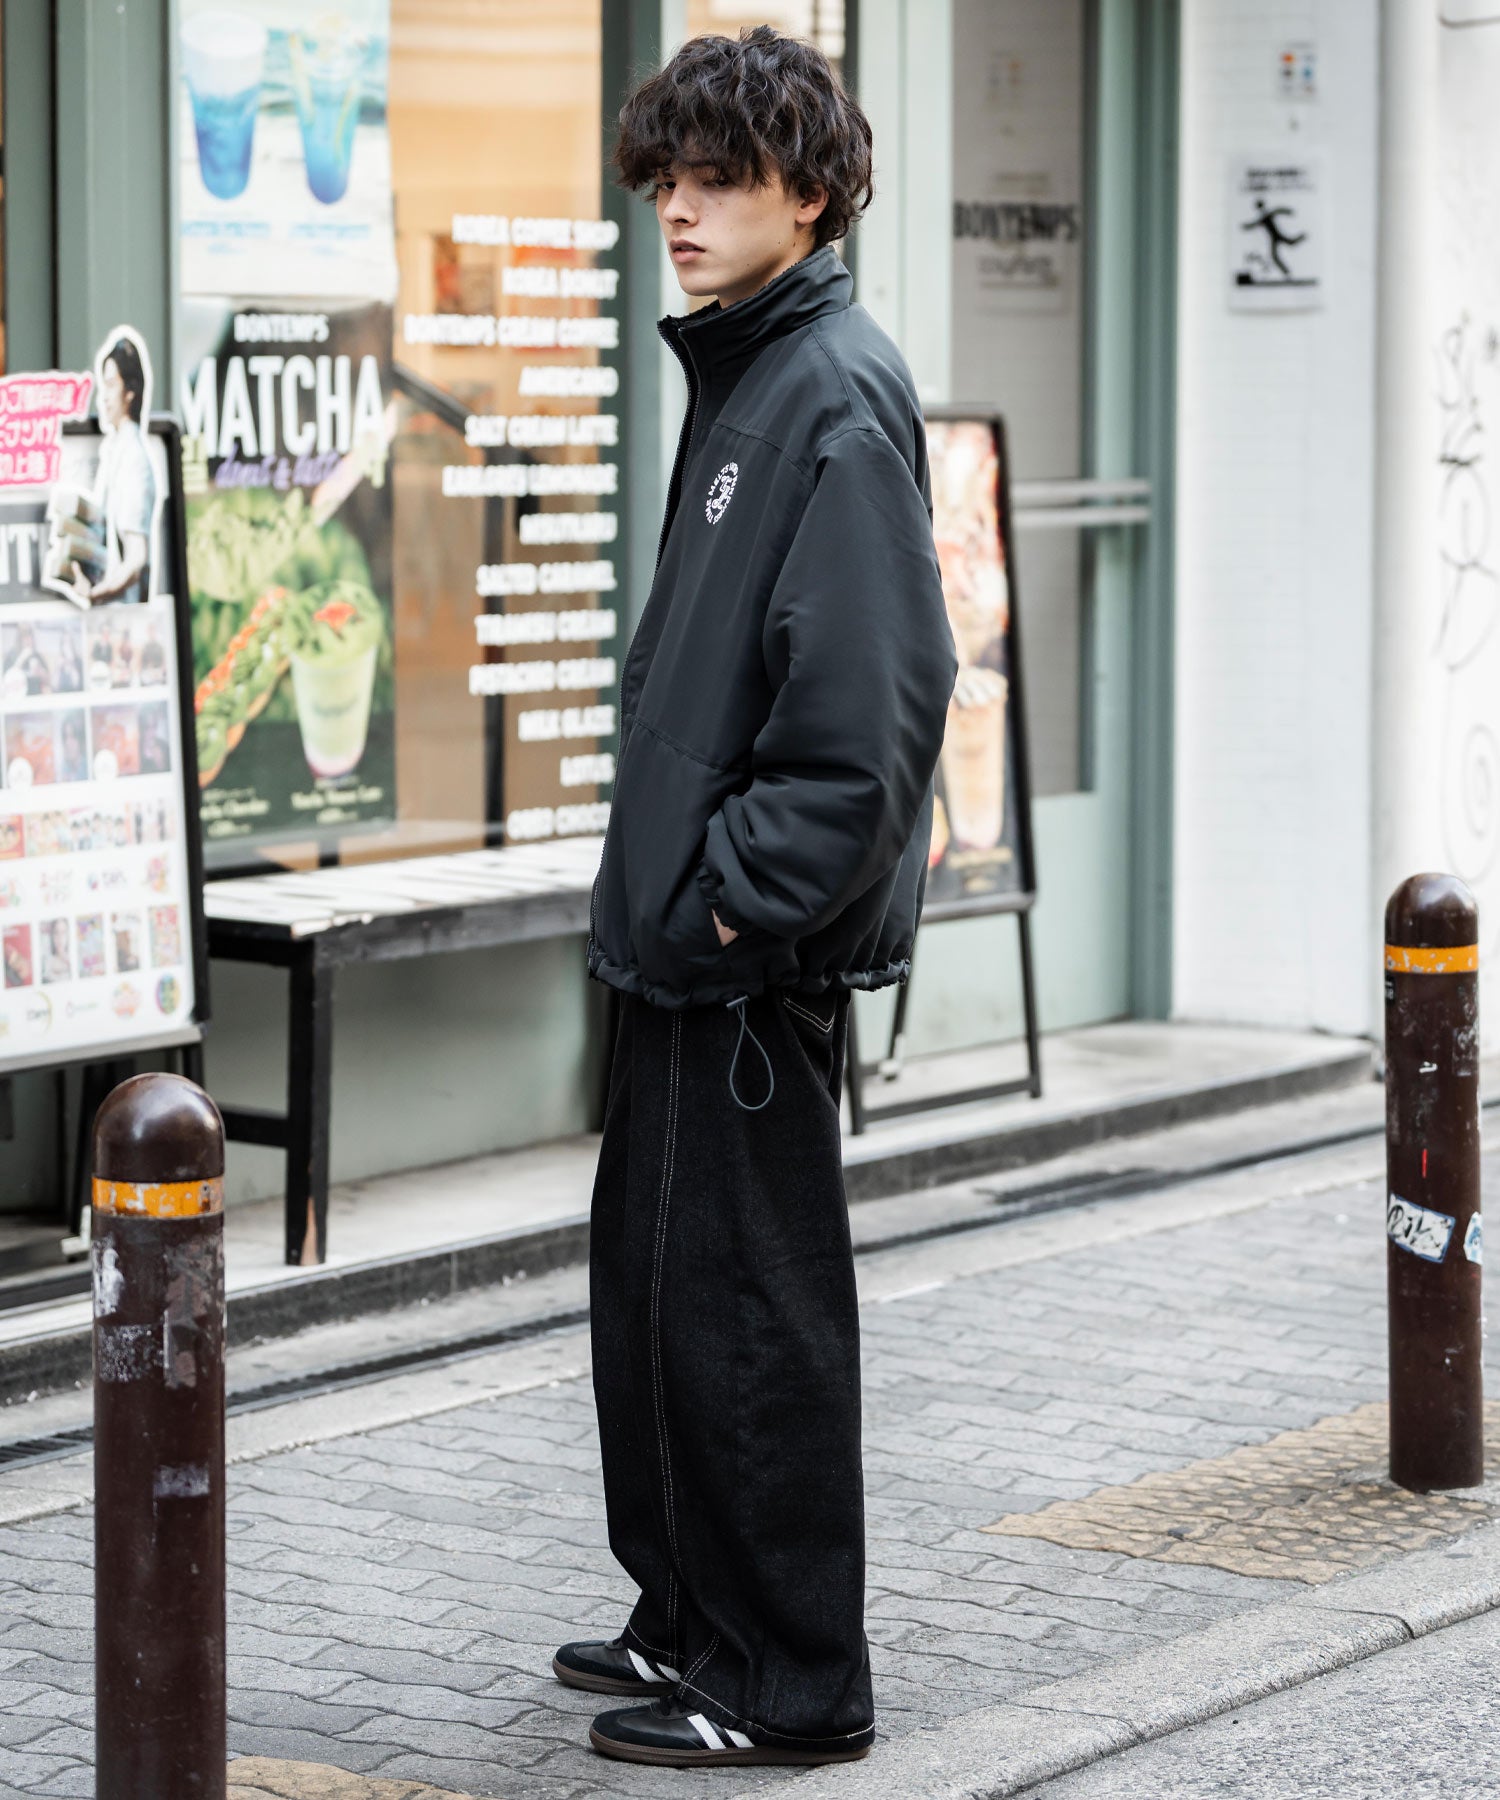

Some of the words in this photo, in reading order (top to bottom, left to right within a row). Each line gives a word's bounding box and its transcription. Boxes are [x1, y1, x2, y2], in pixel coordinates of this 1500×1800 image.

[234, 314, 329, 342] BONTEMPS
[518, 366, 618, 396] AMERICANO
[182, 354, 387, 457] MATCHA
